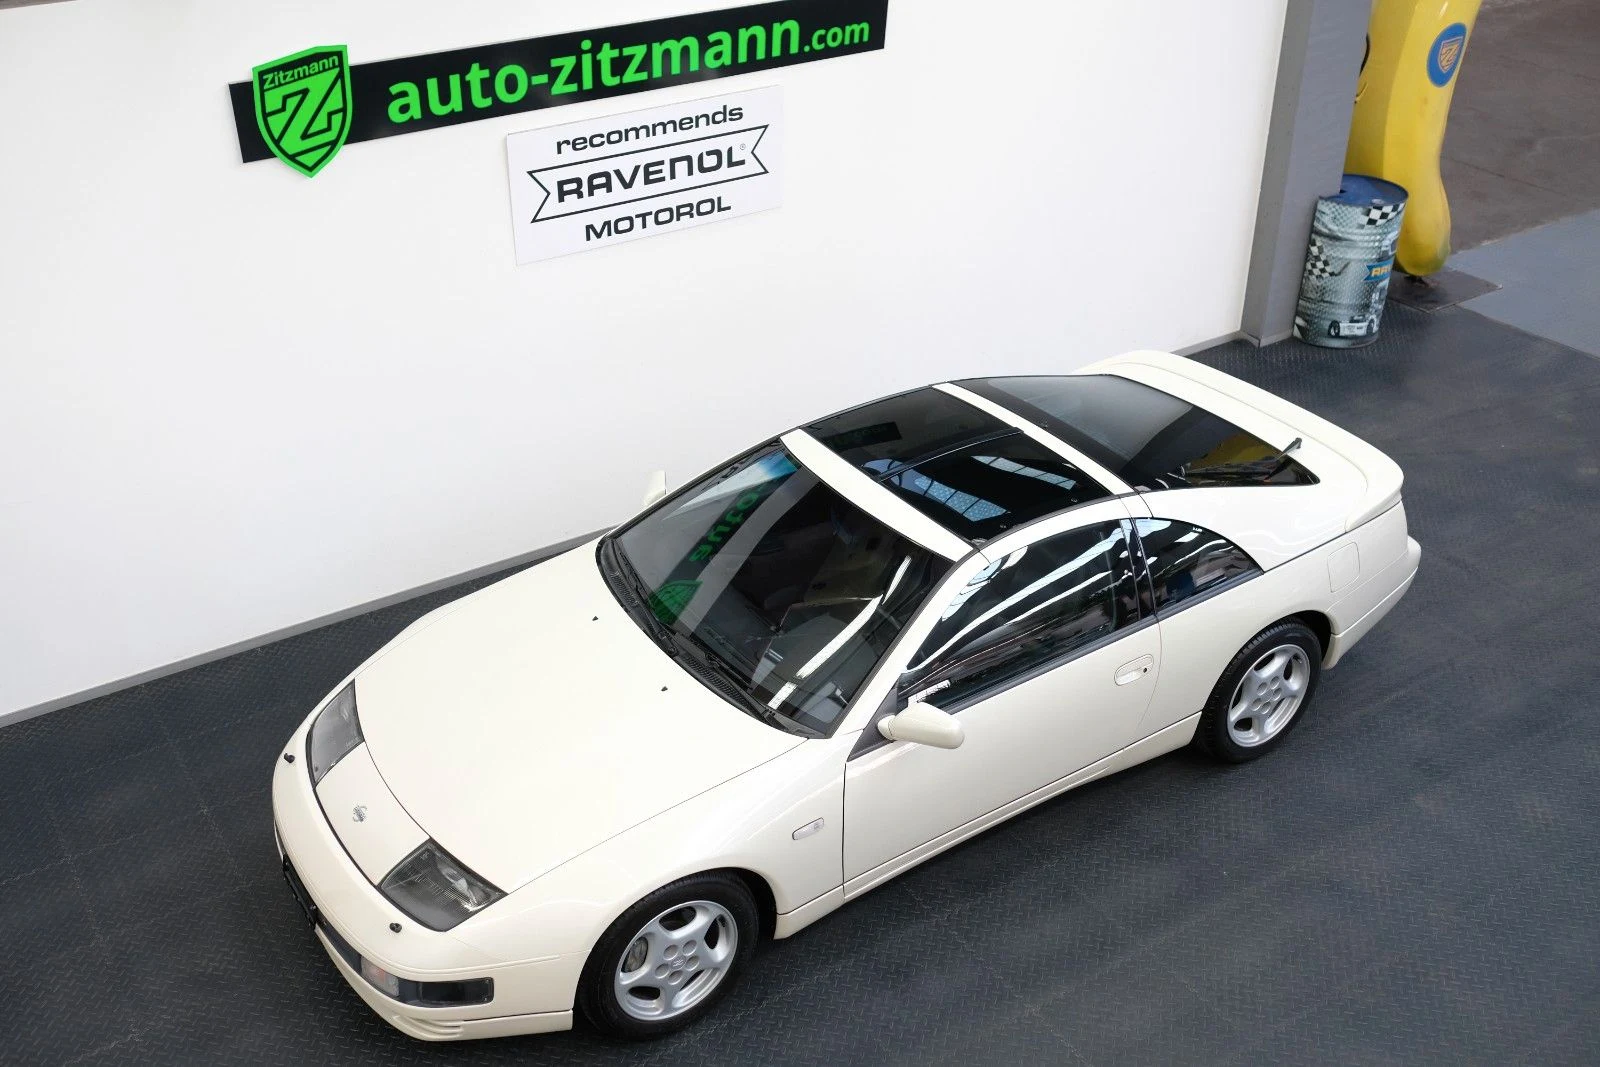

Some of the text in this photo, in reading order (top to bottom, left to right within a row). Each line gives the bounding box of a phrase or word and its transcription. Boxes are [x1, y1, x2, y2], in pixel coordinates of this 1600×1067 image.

[262, 55, 339, 90] Zitzmann
[387, 19, 871, 124] auto-zitzmann.com
[556, 104, 744, 155] recommends
[556, 145, 746, 204] RAVENOL
[585, 196, 732, 242] MOTOROL
